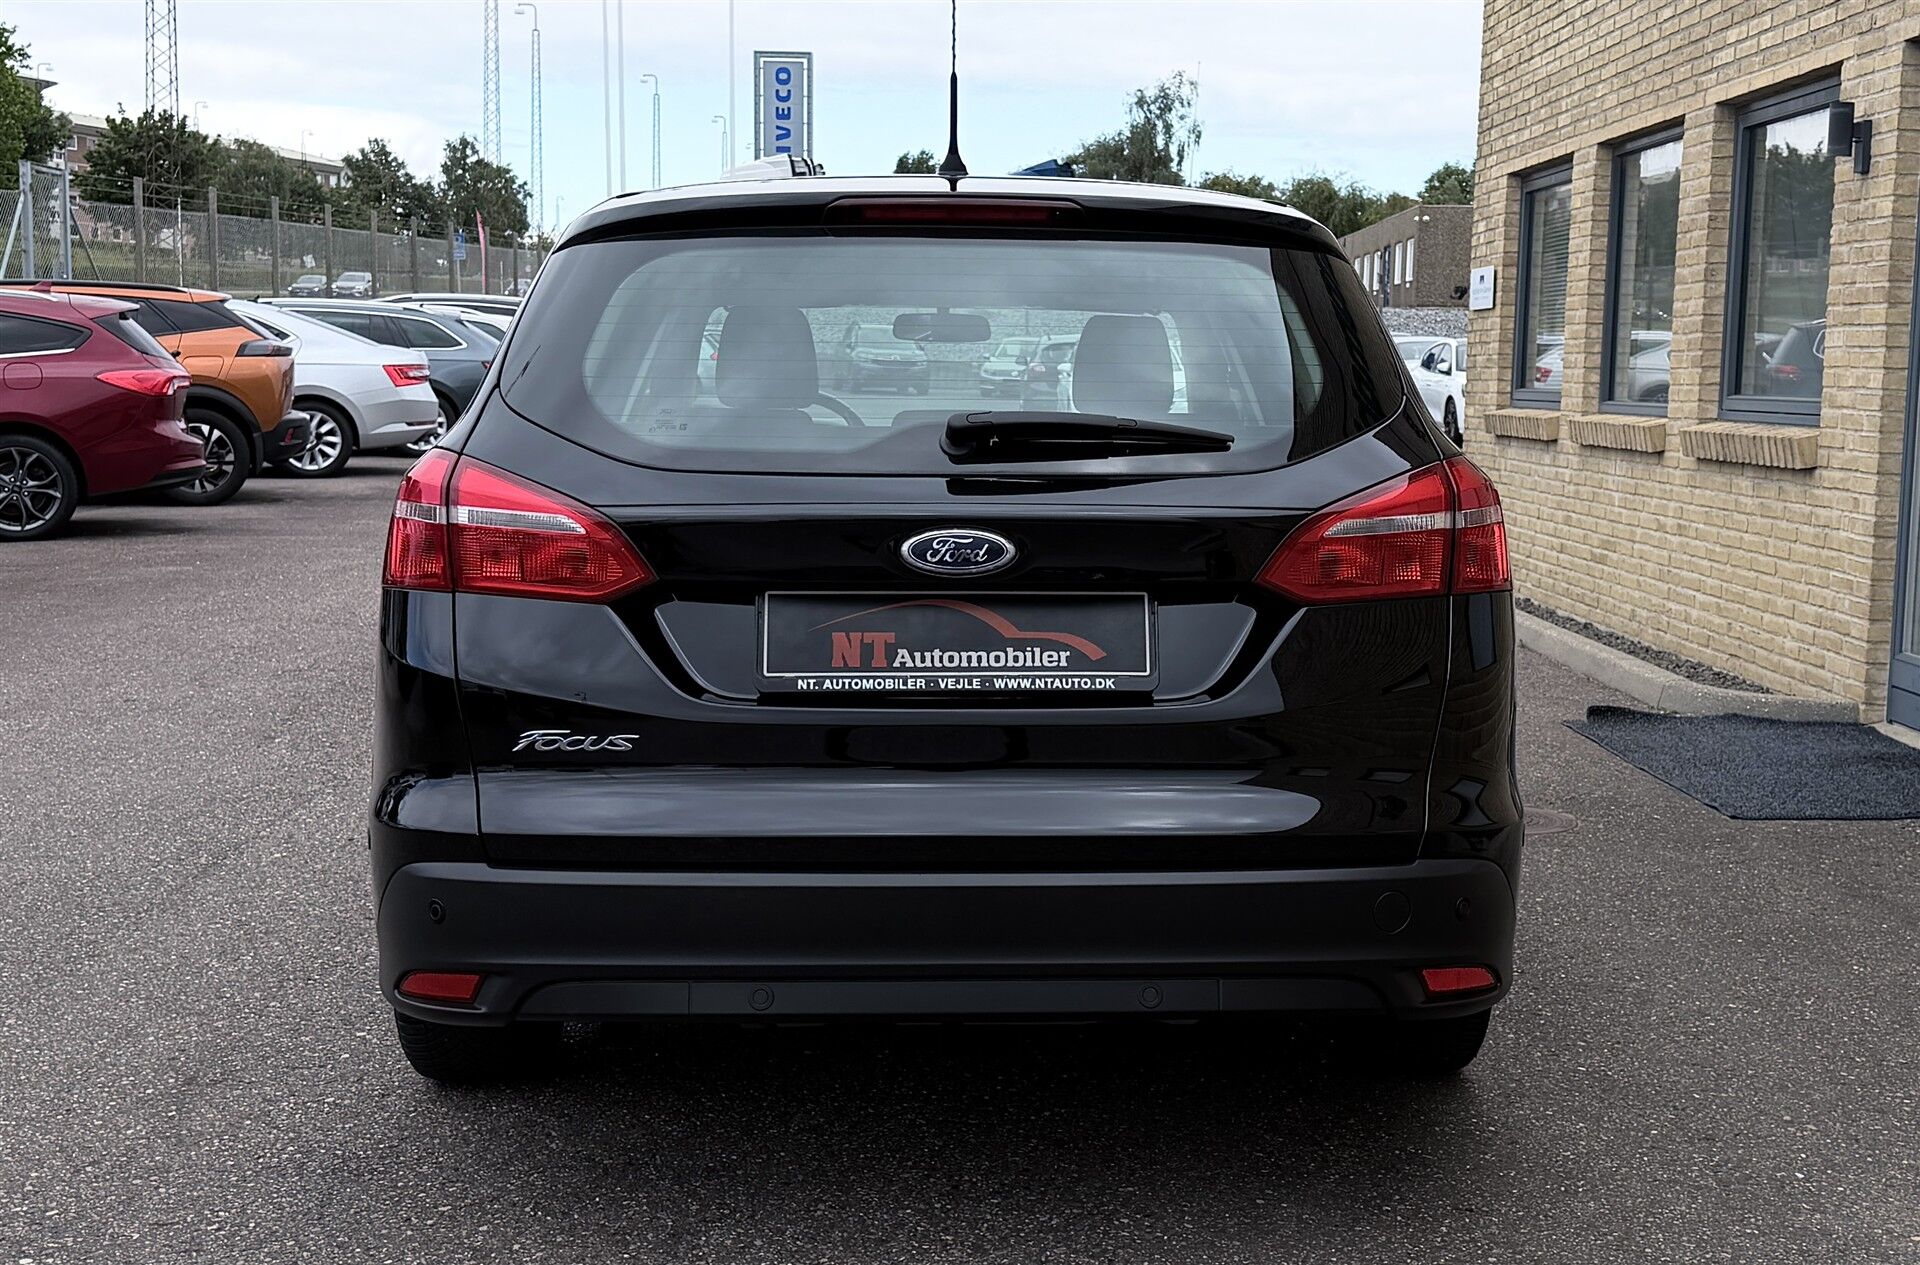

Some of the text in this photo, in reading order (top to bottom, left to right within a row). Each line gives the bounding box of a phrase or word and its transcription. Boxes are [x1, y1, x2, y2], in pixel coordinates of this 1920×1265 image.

[775, 66, 791, 153] IVECO
[926, 537, 989, 562] Ford
[831, 632, 1070, 668] NT Automobiler
[797, 678, 1116, 690] NT. AUTOMOBILER VEJLE WWW.NTAUTO.DK
